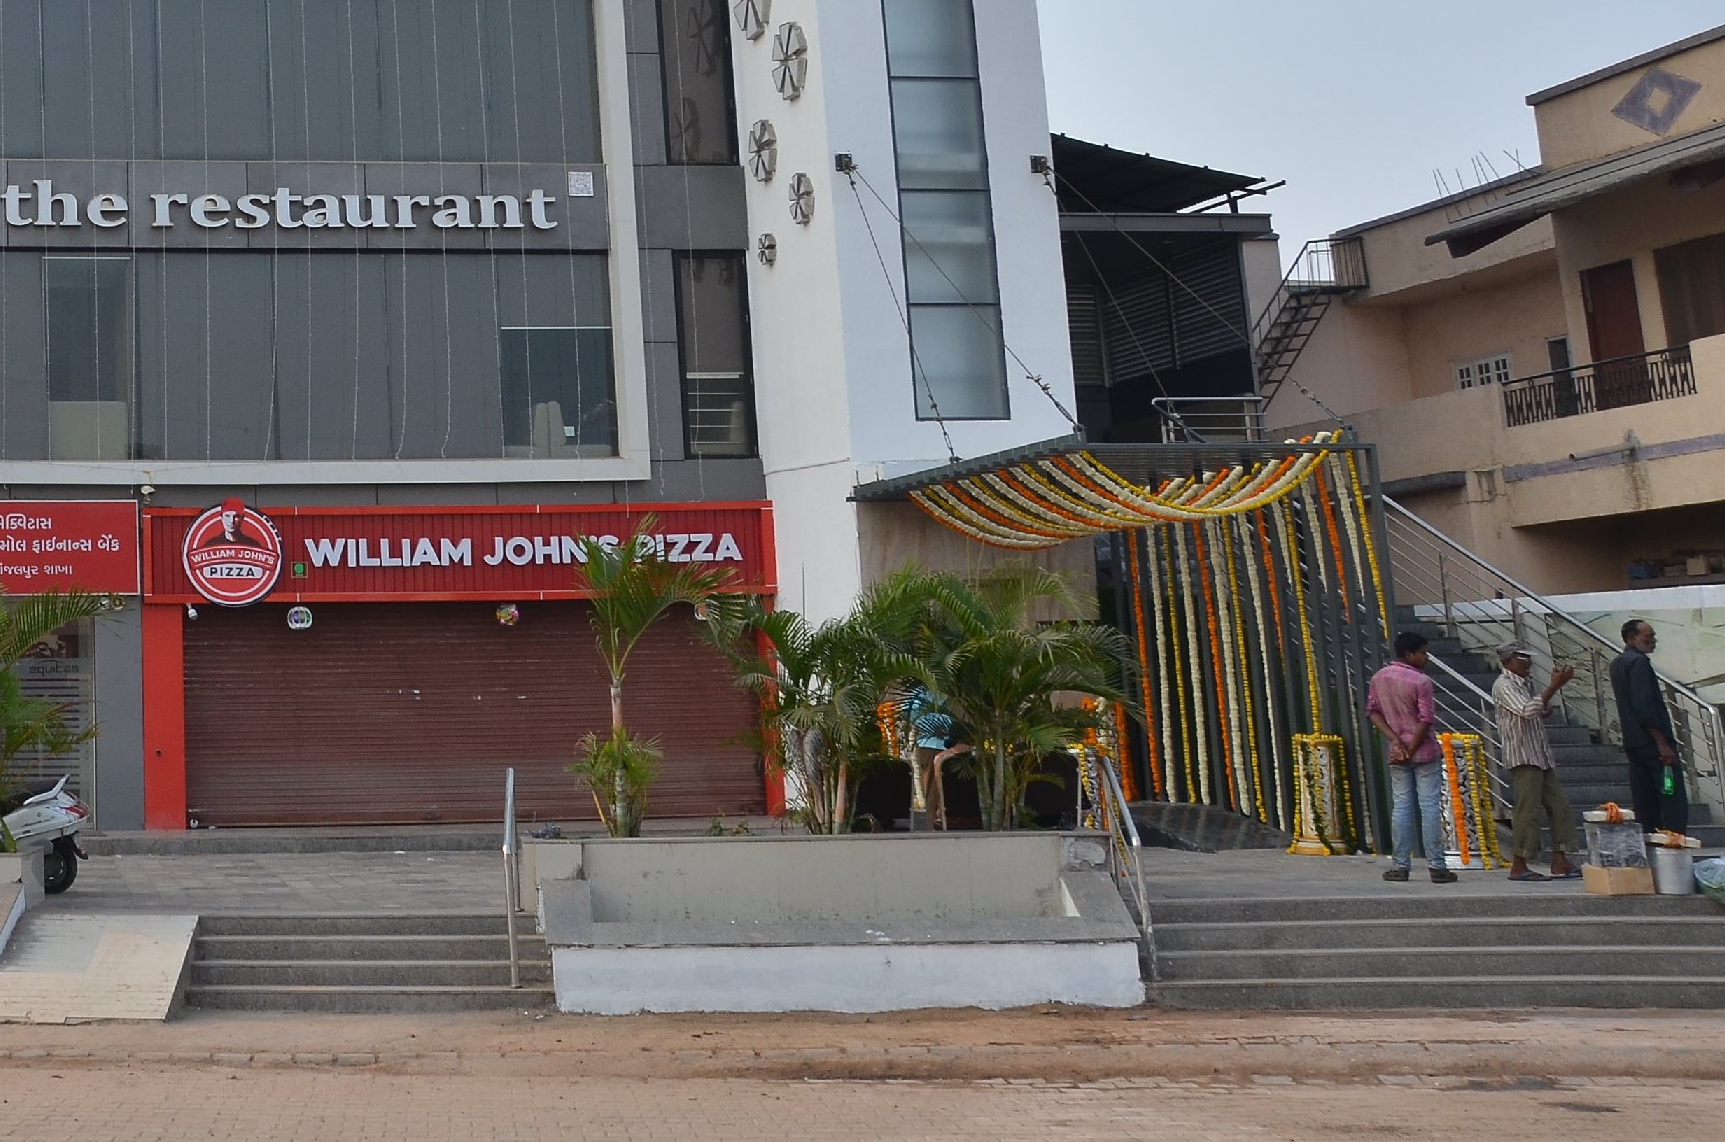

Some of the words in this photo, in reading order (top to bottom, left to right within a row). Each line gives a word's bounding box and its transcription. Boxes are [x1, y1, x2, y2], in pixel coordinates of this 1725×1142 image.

[1, 179, 129, 228] the
[150, 186, 559, 230] restaurant
[191, 550, 235, 563] WILLIAM
[238, 550, 275, 564] JOHN'S
[304, 537, 472, 568] WILLIAM
[634, 533, 744, 563] PIZZA
[43, 565, 73, 575] શાખા
[209, 567, 255, 577] PIZZA
[29, 662, 79, 676] equitas
